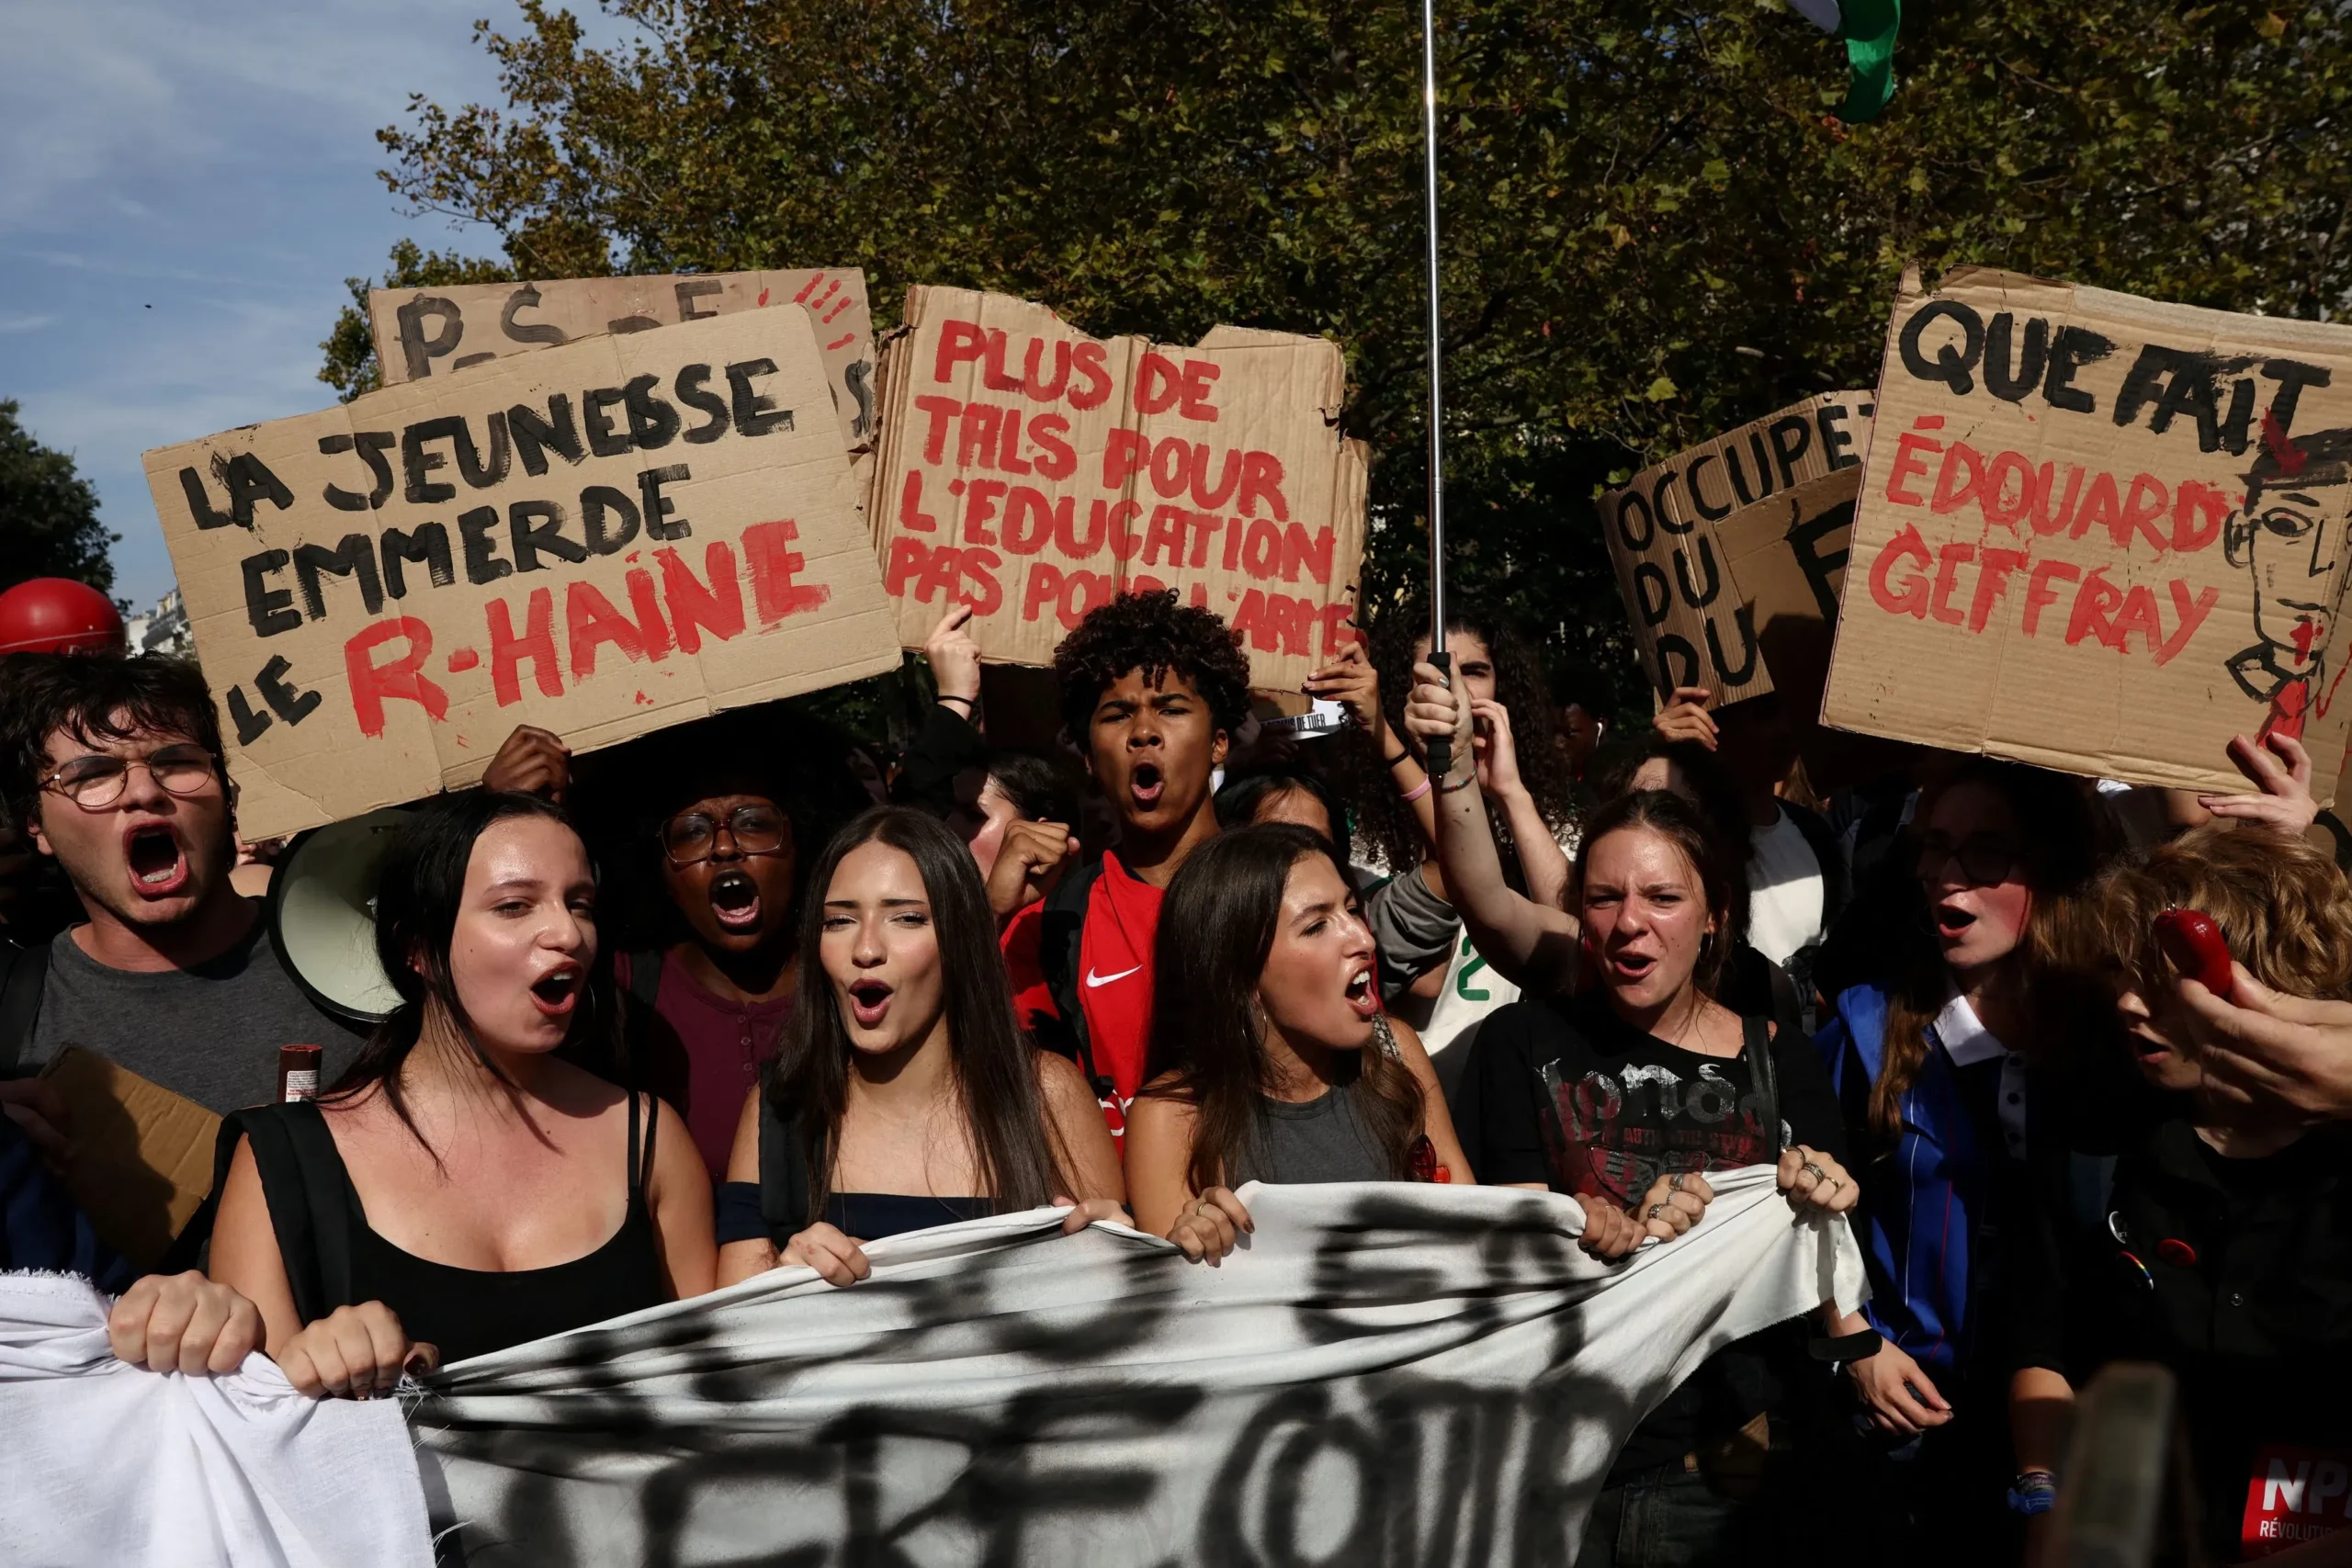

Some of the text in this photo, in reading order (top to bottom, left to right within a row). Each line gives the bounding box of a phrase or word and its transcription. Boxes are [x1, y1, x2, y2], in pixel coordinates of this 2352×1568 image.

[933, 319, 1114, 411] PLUS
[1133, 352, 1221, 423] DE
[1898, 299, 2332, 457] QUE FAIT
[179, 451, 295, 531] LA
[318, 357, 795, 513] JEUNESSE
[1102, 427, 1289, 522] POUR
[1617, 403, 1875, 550] OCCUPE
[1885, 415, 2233, 553] ÉDOUARD
[241, 462, 693, 637] EMMERDE
[886, 536, 1002, 616] PAS
[899, 469, 1337, 585] L'EDUCATION
[1634, 533, 1721, 627] DU
[1868, 522, 2220, 668] GEFFRAY
[226, 653, 322, 746] LE
[1656, 596, 1757, 705] DU
[1306, 714, 1326, 729] TUER
[2261, 1457, 2352, 1519] NP
